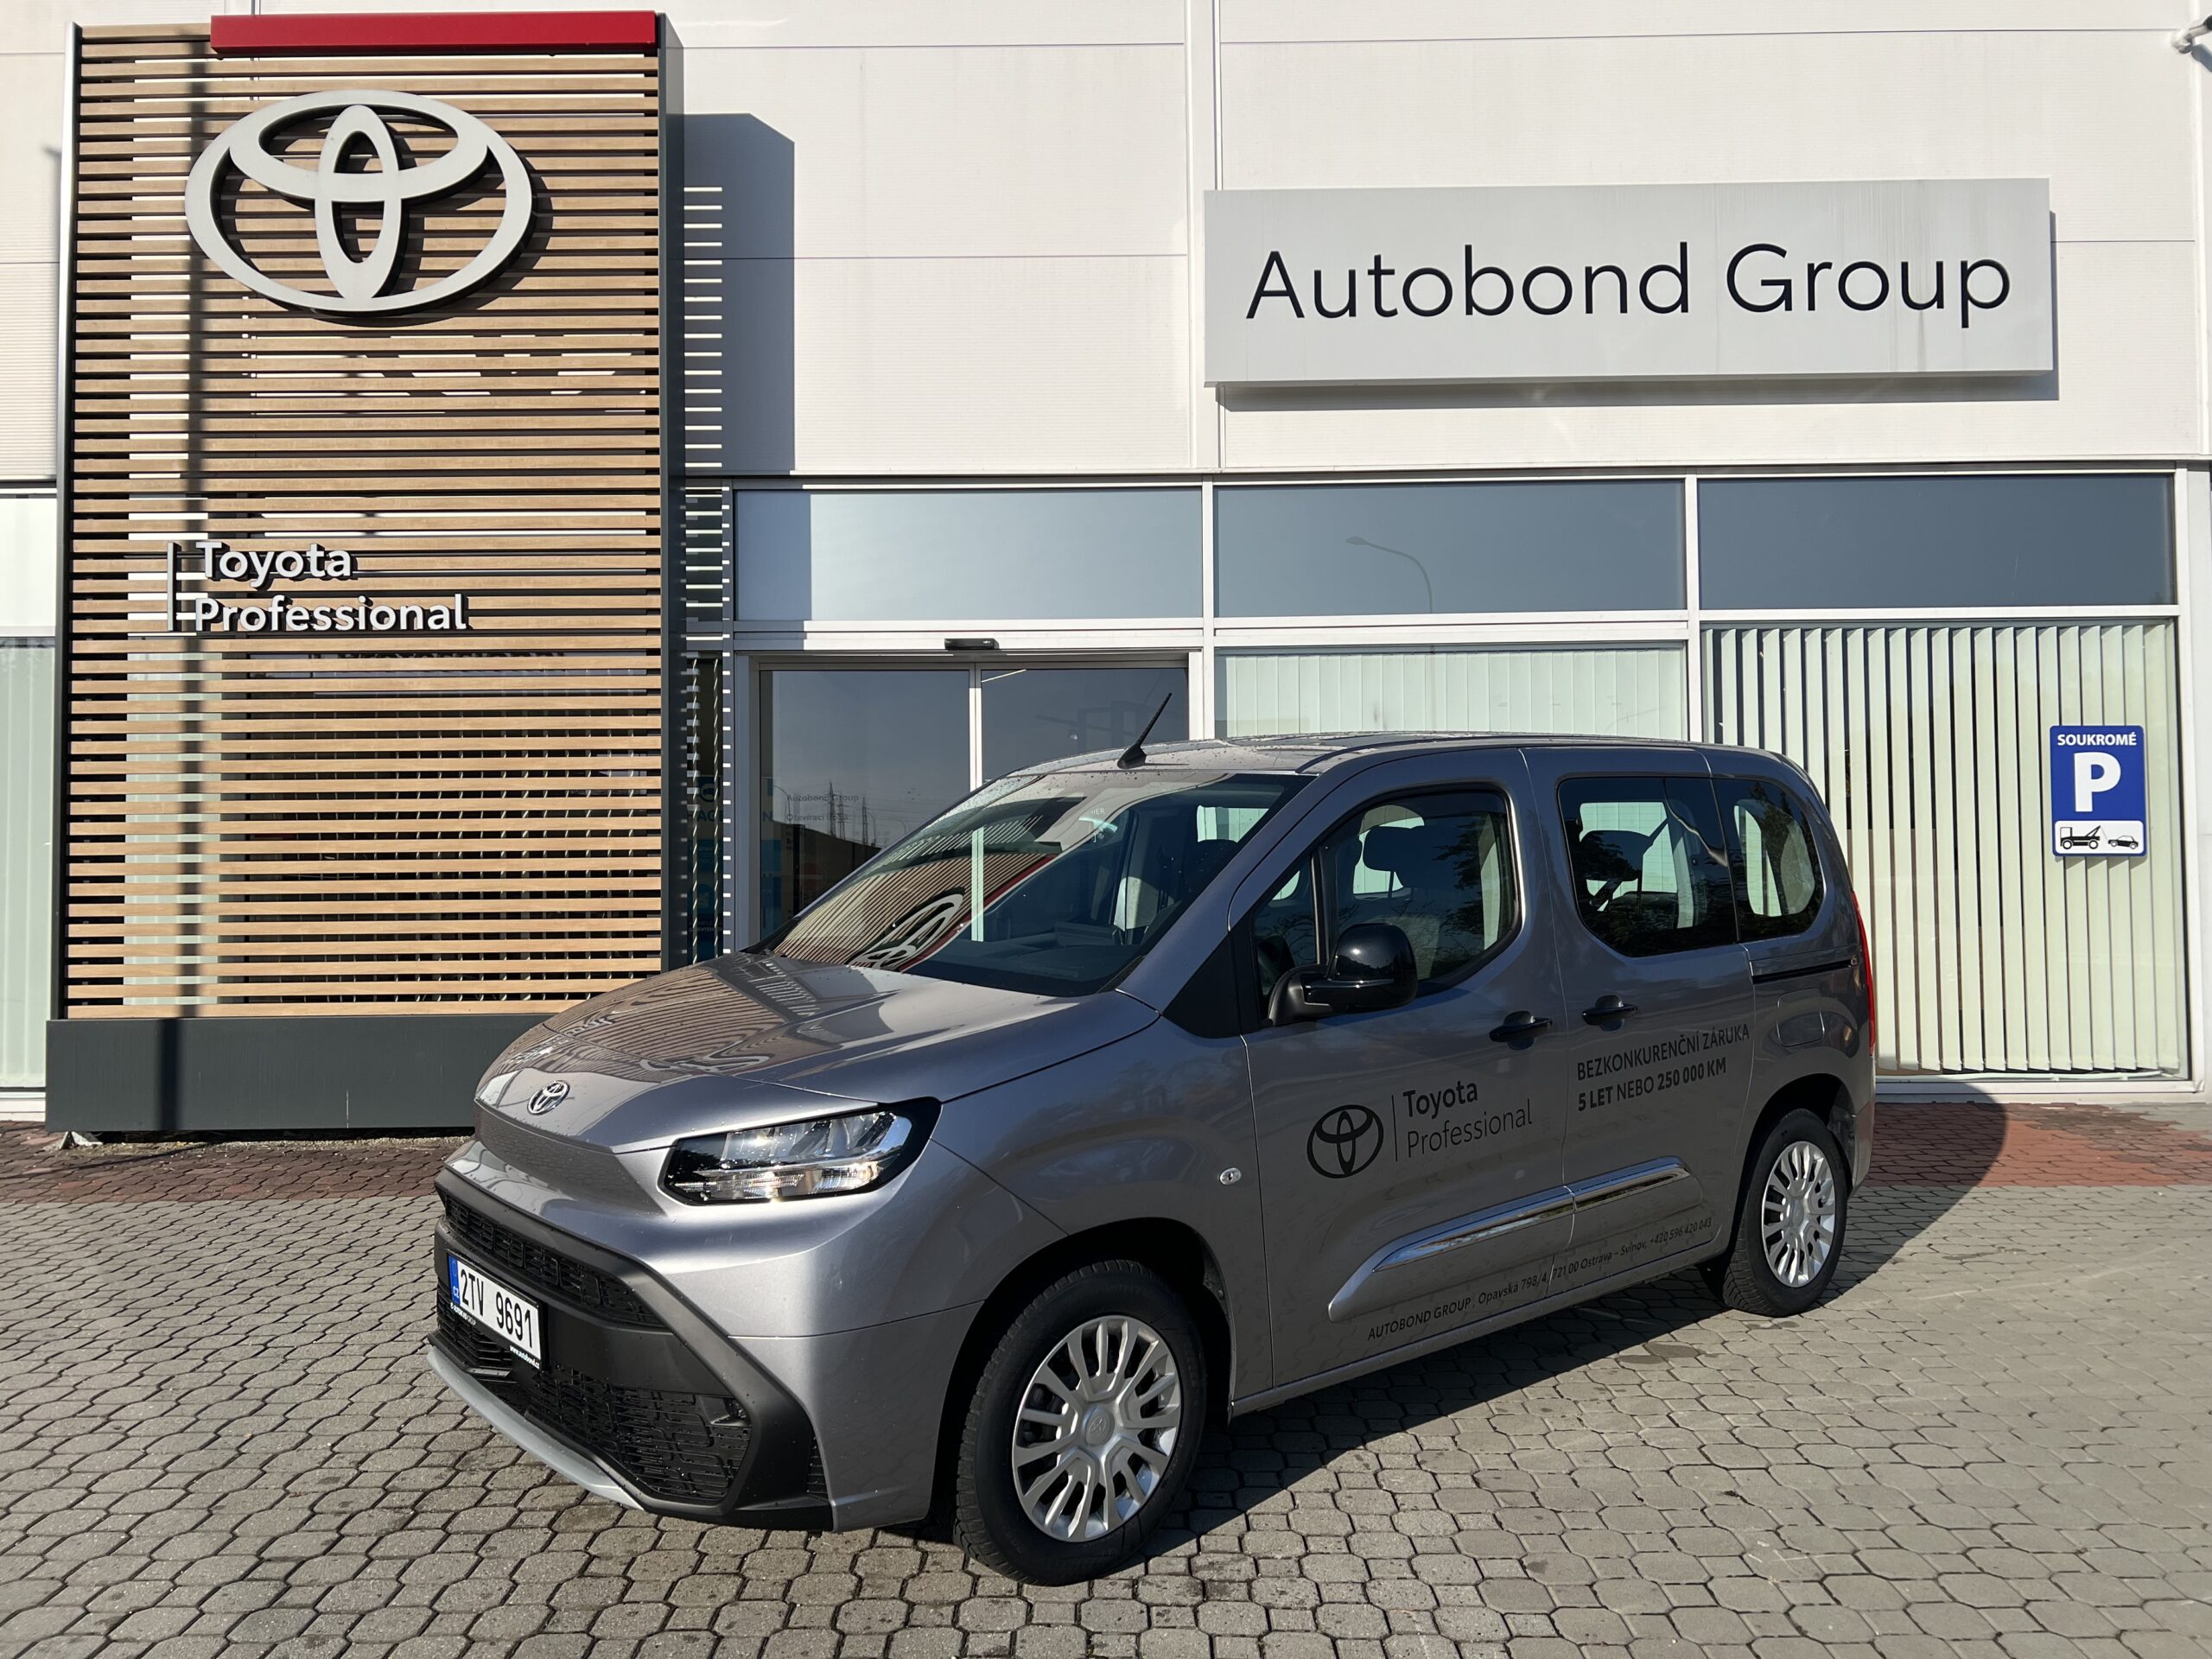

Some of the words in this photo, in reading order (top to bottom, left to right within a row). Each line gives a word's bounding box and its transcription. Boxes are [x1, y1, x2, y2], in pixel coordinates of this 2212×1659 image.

[1245, 241, 1689, 321] Autobond
[1726, 243, 2012, 328] Group
[195, 541, 353, 588] Toyota
[195, 593, 467, 632] Professional
[2056, 731, 2138, 746] SOUKROMÉ
[2074, 751, 2122, 812] P
[1577, 1031, 1700, 1080] BEZKONKURENČNÍ
[1702, 1023, 1750, 1051] ZÁRUKA
[1402, 1080, 1478, 1120] Toyota
[1578, 1092, 1586, 1112] 5
[1590, 1085, 1613, 1109] LET
[1617, 1076, 1655, 1102] NEBO
[1657, 1069, 1681, 1090] 250
[1683, 1062, 1705, 1084] 000
[1707, 1057, 1726, 1077] KM
[1408, 1098, 1533, 1158] Professional
[460, 1268, 484, 1317] 2TV
[495, 1291, 532, 1349] 9691
[1367, 1310, 1432, 1341] AUTOBOND
[1568, 1261, 1580, 1274] 00
[1580, 1252, 1612, 1270] Ostrava
